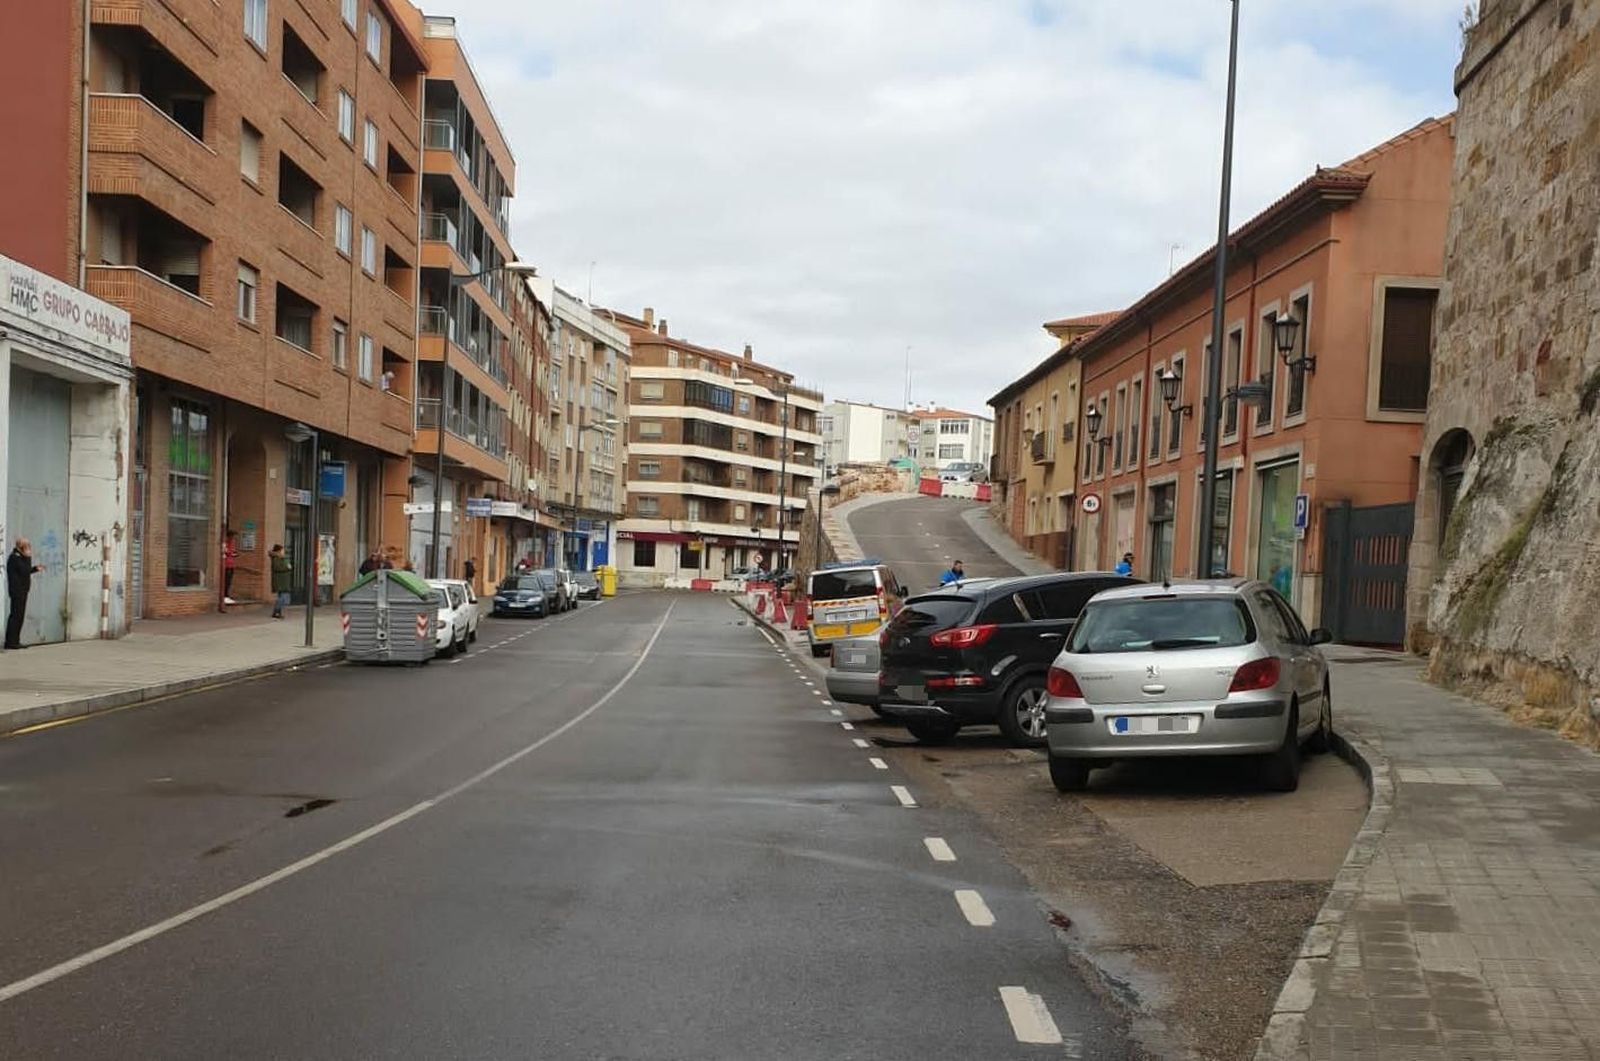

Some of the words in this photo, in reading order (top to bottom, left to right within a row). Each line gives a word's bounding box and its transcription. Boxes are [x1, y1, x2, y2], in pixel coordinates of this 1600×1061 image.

[10, 286, 39, 313] HMC
[43, 291, 80, 323] GRUPO
[84, 309, 129, 342] CARBAJO
[1296, 498, 1305, 526] P
